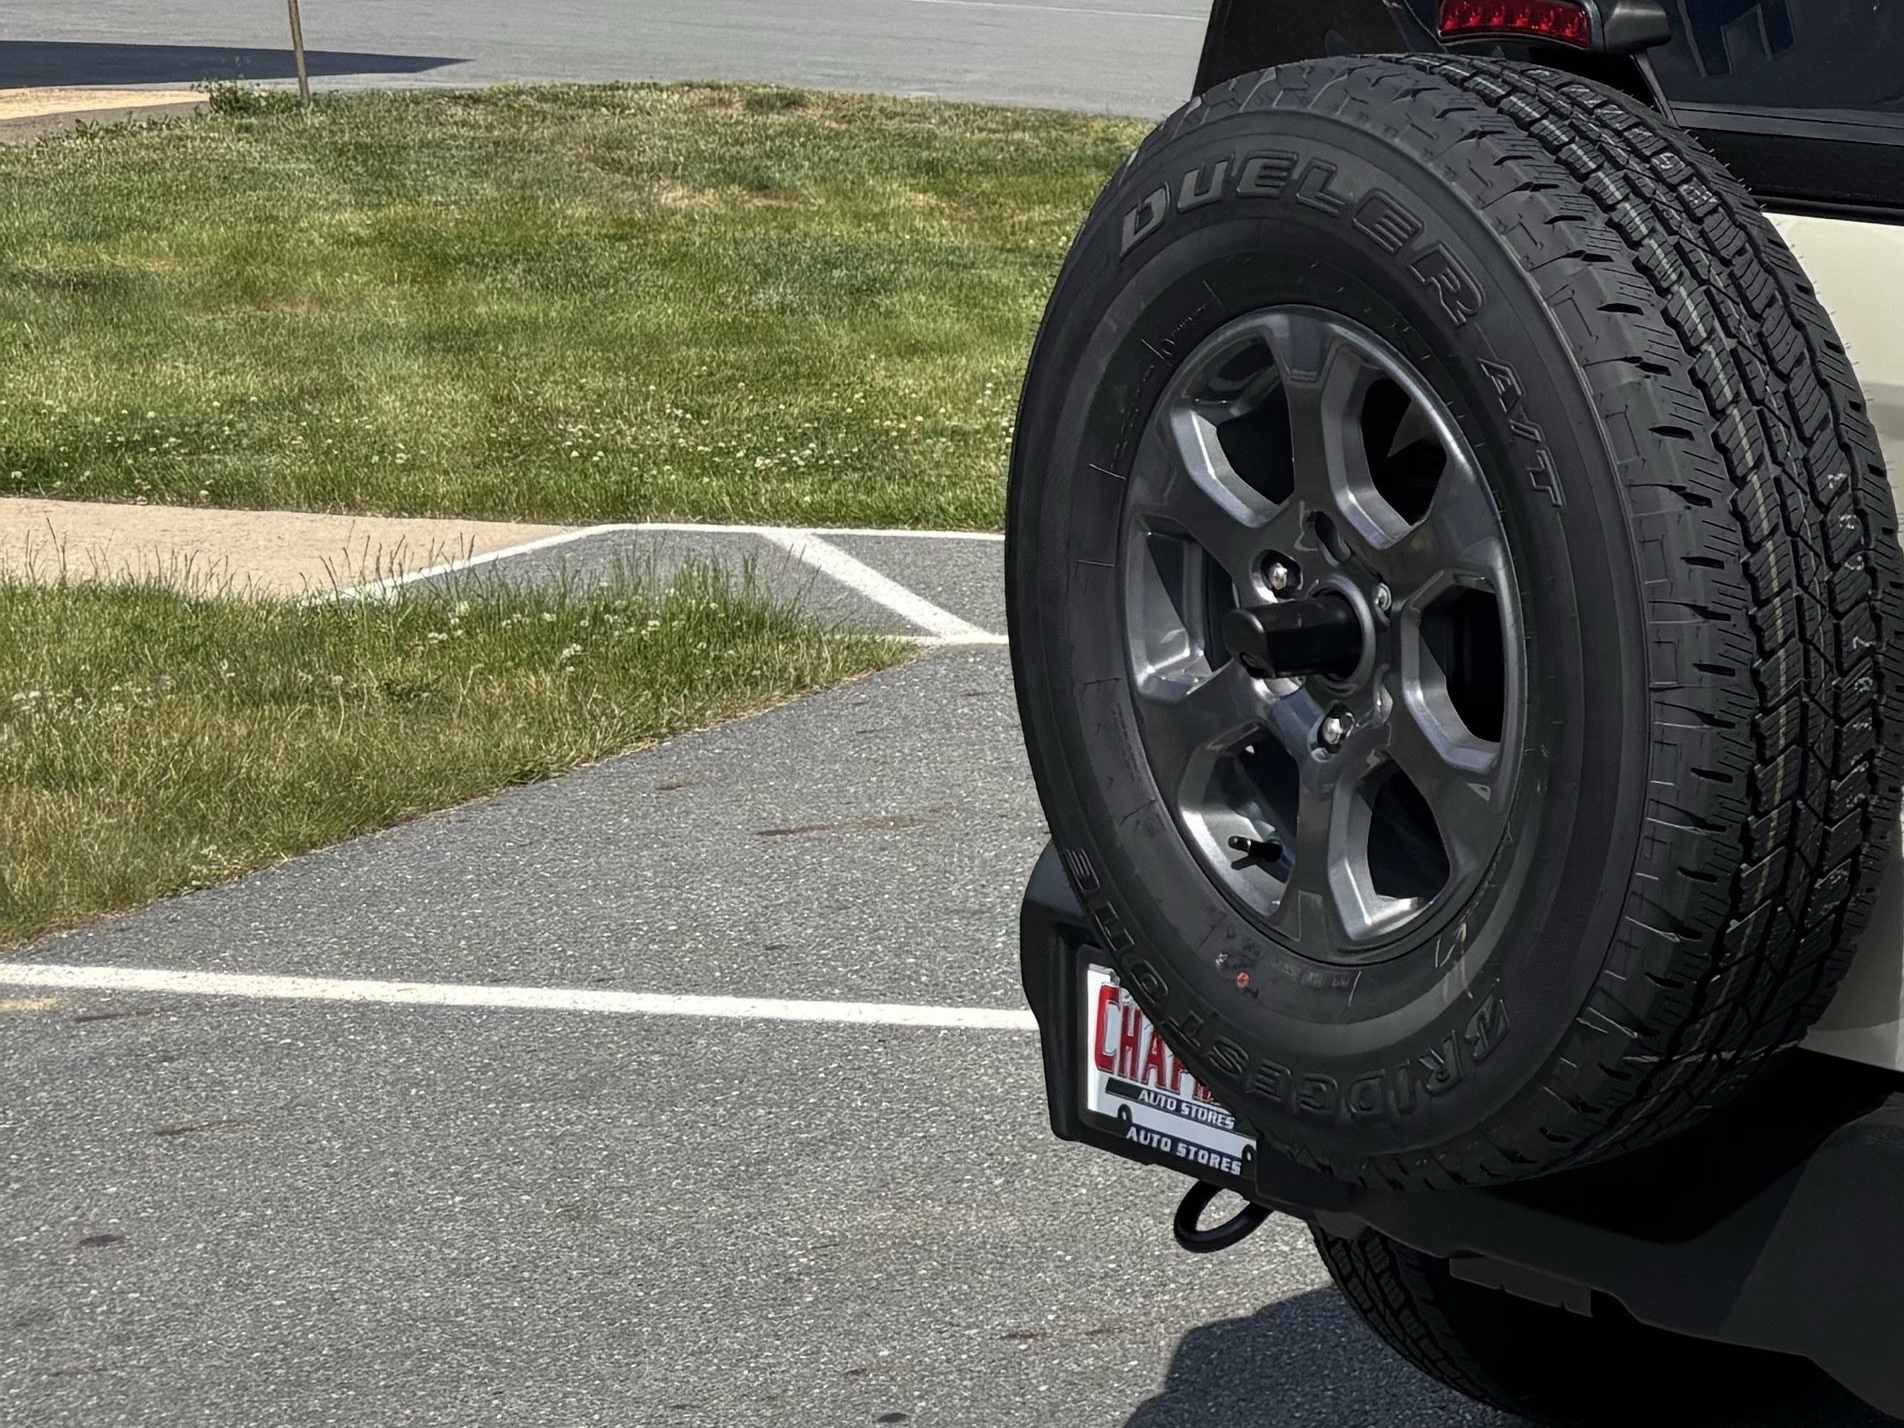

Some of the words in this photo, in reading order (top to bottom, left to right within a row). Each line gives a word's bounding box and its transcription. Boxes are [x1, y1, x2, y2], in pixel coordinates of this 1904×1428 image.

[1120, 148, 1486, 328] DUELER
[1064, 847, 1512, 1120] BRIDGESTONE
[1126, 1126, 1172, 1152] AUTO
[1176, 1142, 1243, 1176] STORES
[1138, 1089, 1177, 1111] AUTO
[1180, 1102, 1237, 1130] STORES
